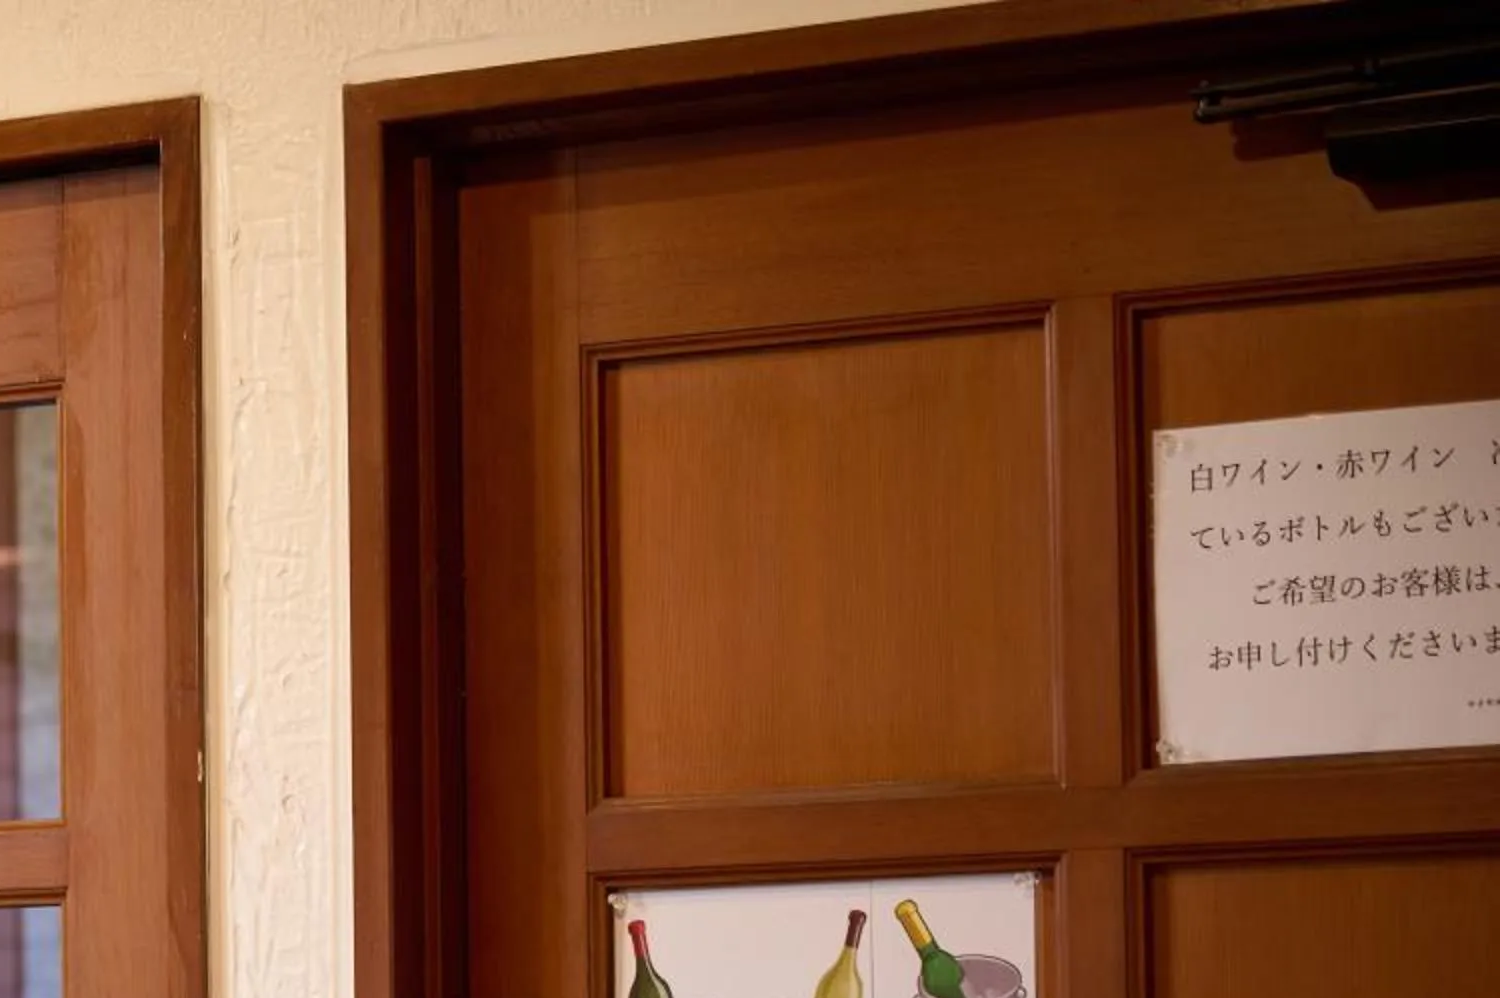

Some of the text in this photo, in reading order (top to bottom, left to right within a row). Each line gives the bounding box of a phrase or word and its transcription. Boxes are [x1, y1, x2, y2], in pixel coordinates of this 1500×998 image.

[1190, 445, 1456, 494] 白ワイン・赤ワイン
[1190, 501, 1500, 550] ているボトルもござい
